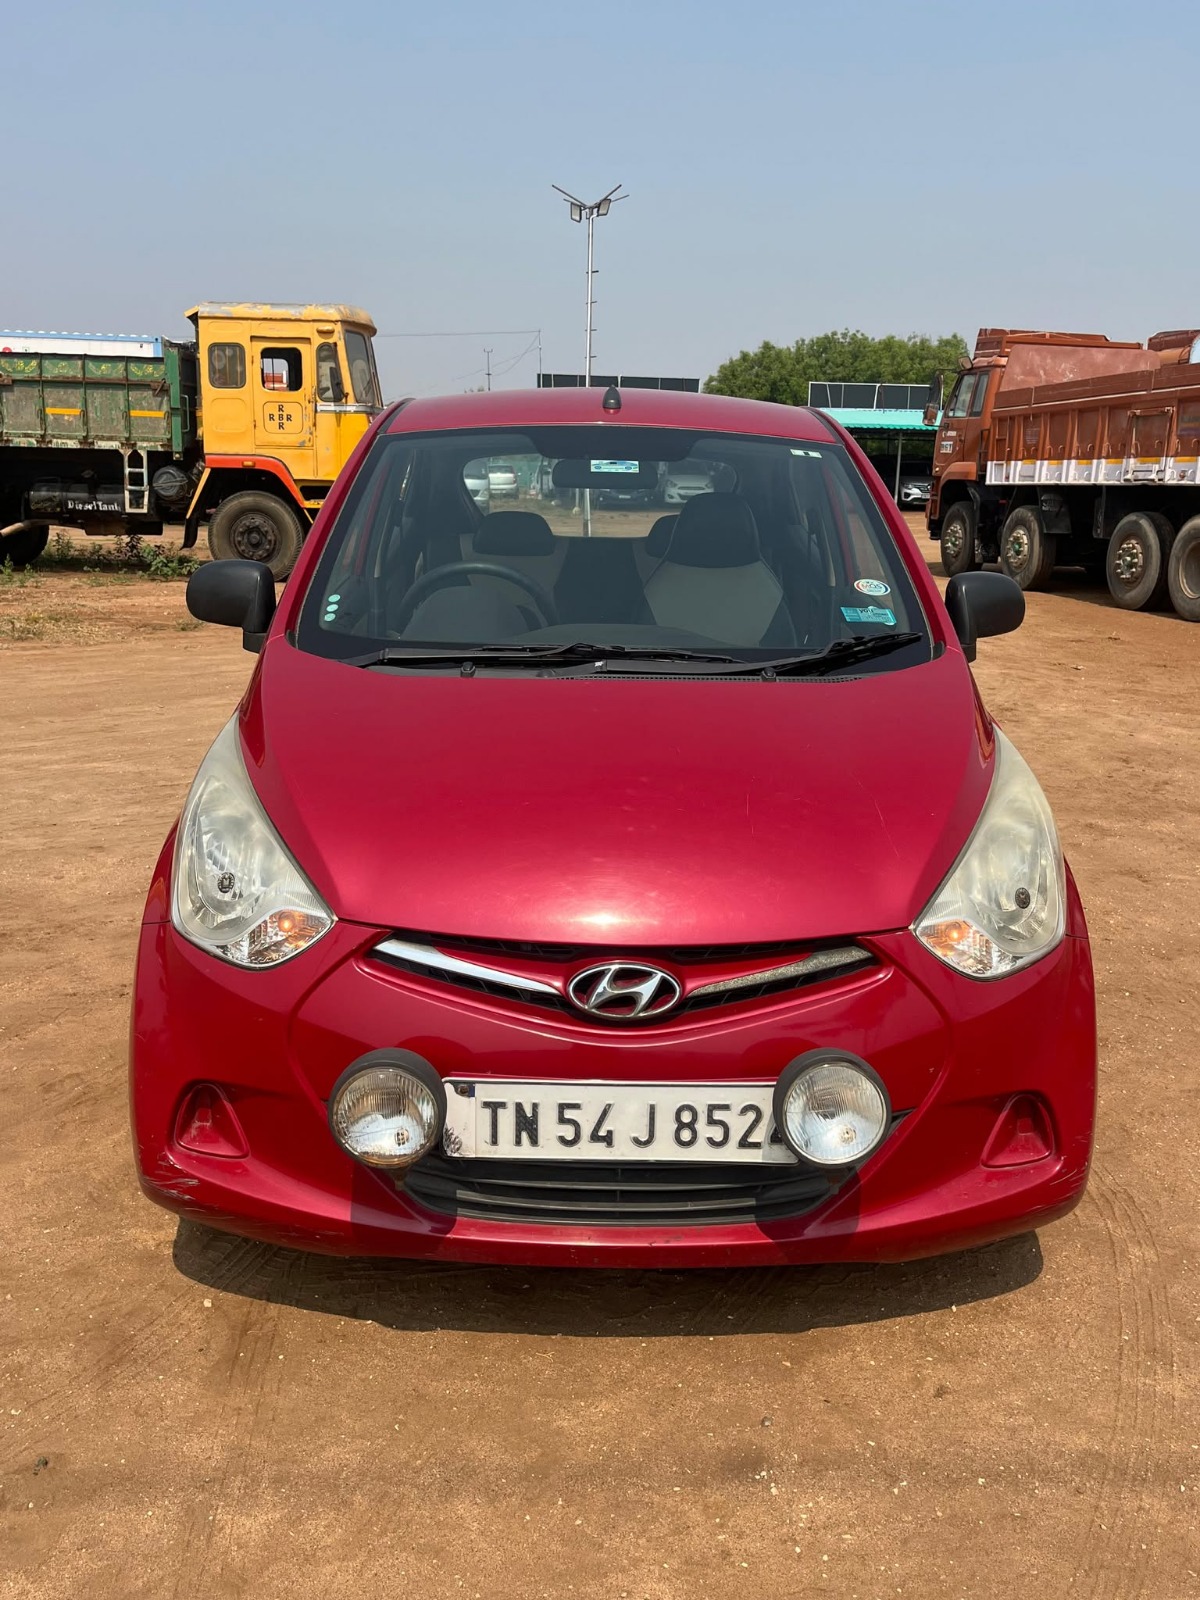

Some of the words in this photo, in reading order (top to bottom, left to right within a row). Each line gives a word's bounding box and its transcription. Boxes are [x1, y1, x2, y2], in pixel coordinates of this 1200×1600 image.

[67, 500, 97, 510] Diesel
[481, 1100, 540, 1147] TN
[557, 1102, 615, 1148] 54
[630, 1102, 656, 1148] J
